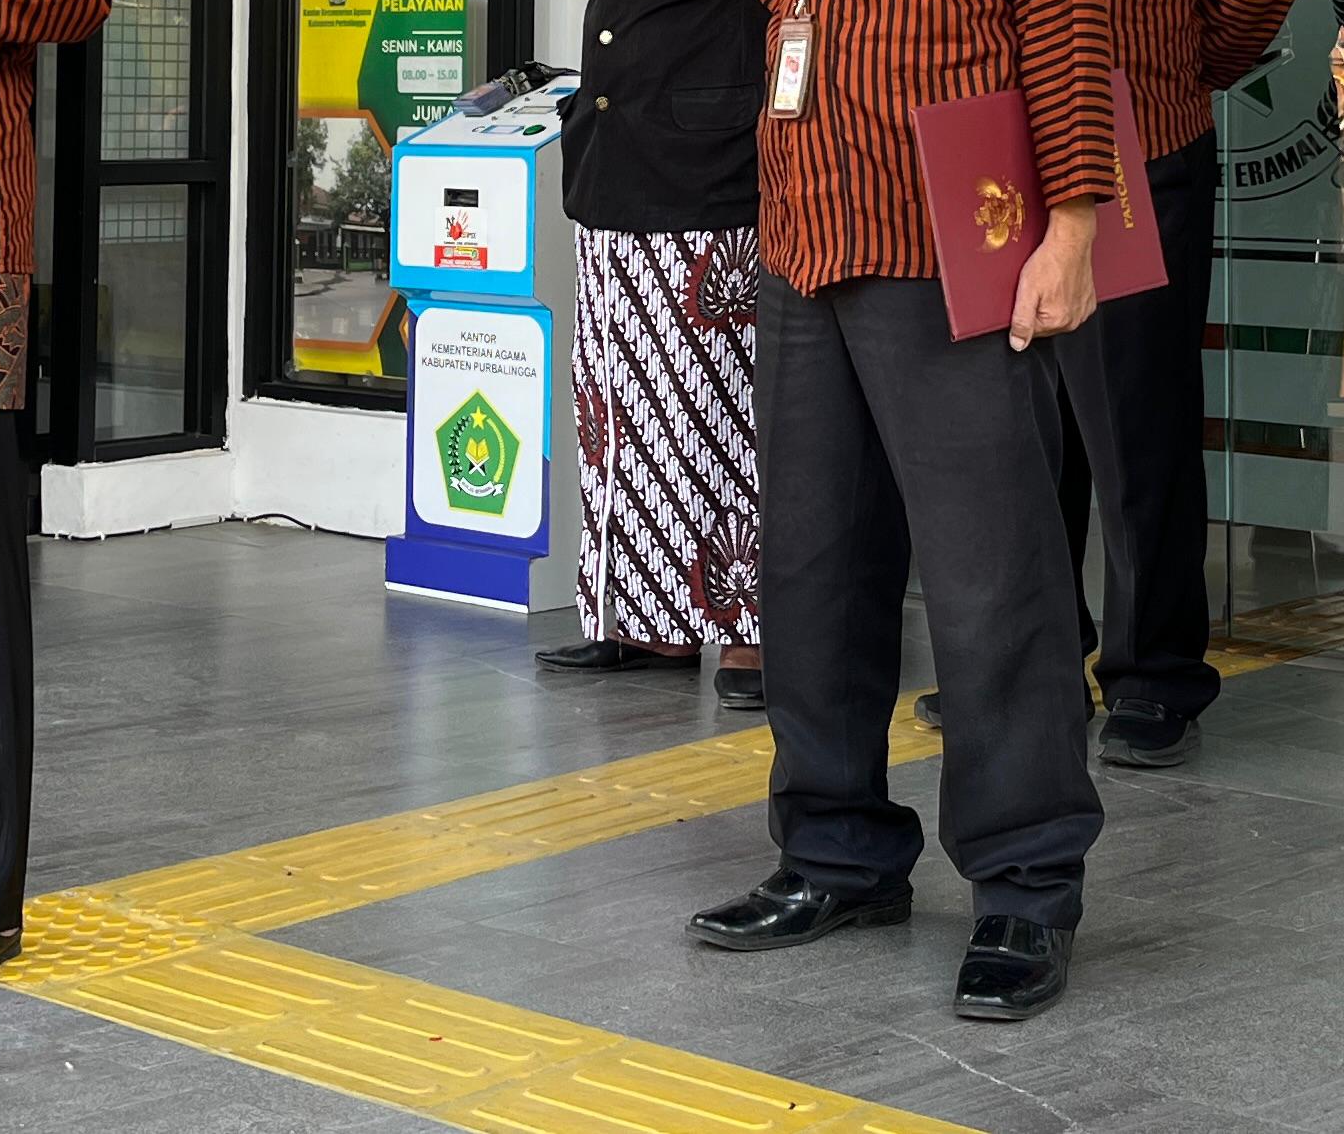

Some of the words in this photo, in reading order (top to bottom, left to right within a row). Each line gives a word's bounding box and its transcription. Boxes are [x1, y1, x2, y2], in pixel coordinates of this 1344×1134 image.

[381, 39, 418, 53] SENIN
[427, 39, 463, 53] KAMIS
[402, 69, 427, 81] 08.00
[436, 69, 458, 81] 15.00
[412, 104, 456, 122] JUM'A
[460, 330, 497, 343] KANTOR
[431, 343, 493, 359] KEMENTERIAN
[495, 348, 527, 362] AGAMA
[421, 356, 472, 372] KABUPATEN
[473, 362, 537, 378] PURBALINGGA
